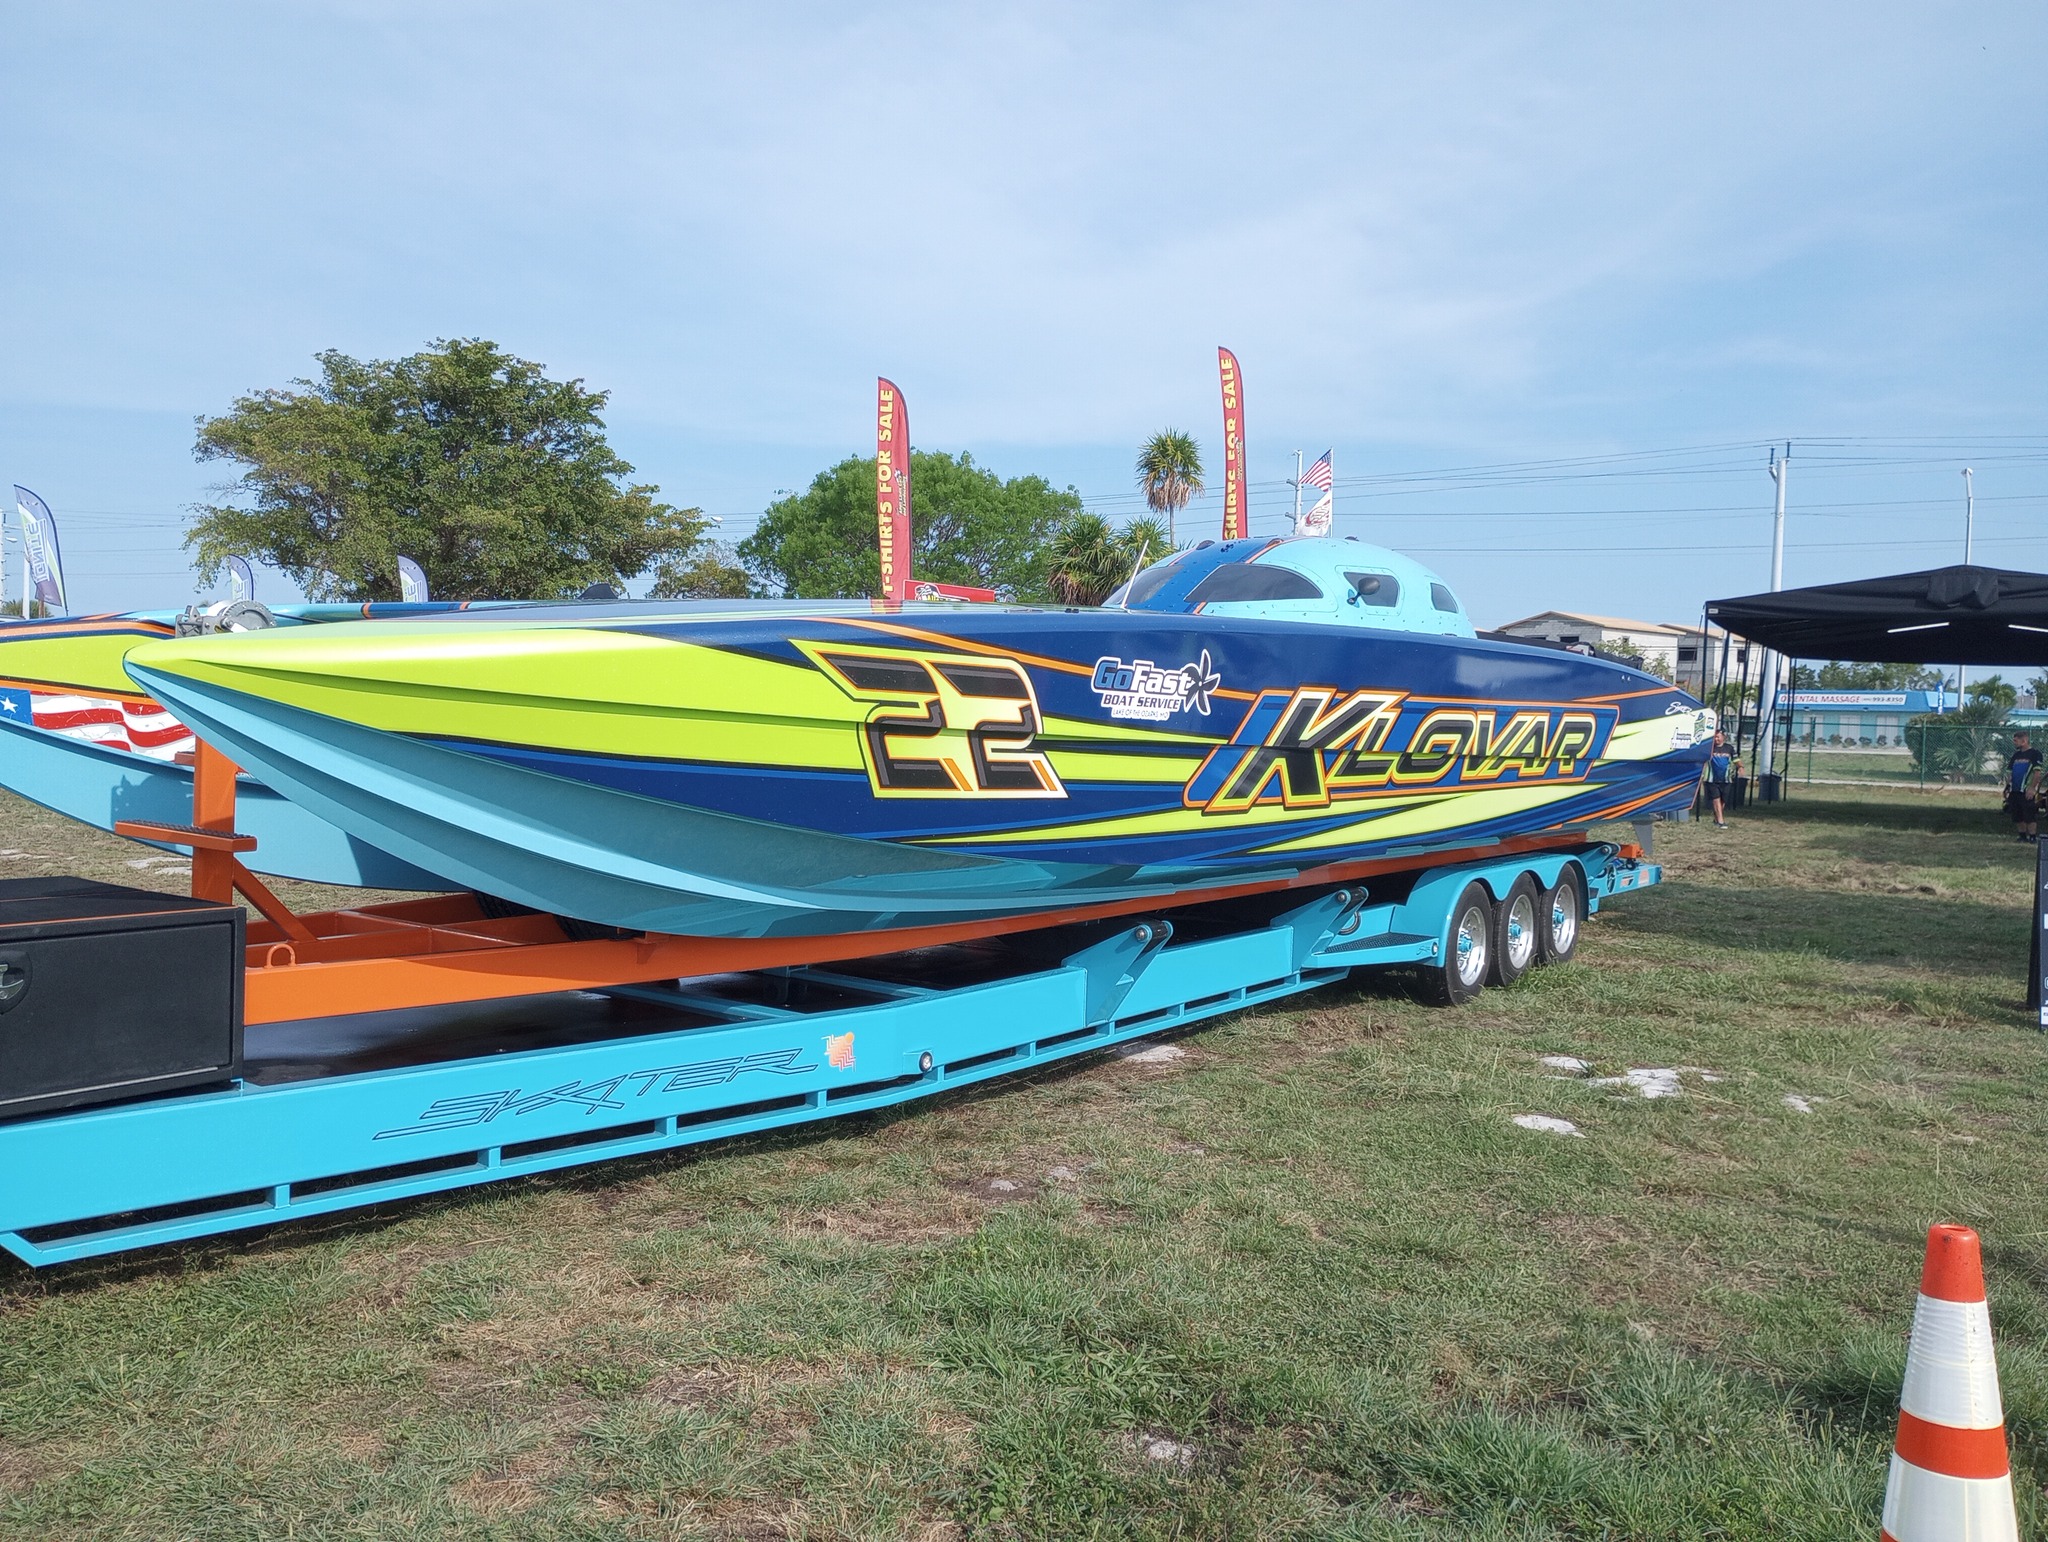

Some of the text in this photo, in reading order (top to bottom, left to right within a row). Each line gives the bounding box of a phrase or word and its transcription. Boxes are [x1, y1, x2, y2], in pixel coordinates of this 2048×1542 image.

[1220, 358, 1237, 410] SALE
[1226, 418, 1238, 462] FOR
[878, 389, 894, 595] T-SHIRTS FOR SALE
[1094, 660, 1192, 696] GoFast
[1103, 694, 1181, 710] BOAT SERVICE
[1780, 695, 1818, 703] OENTAL
[1821, 695, 1861, 703] MASSAGE
[806, 648, 1062, 794] 22
[1204, 688, 1596, 813] KLOVAR
[373, 1047, 819, 1140] SKATER
